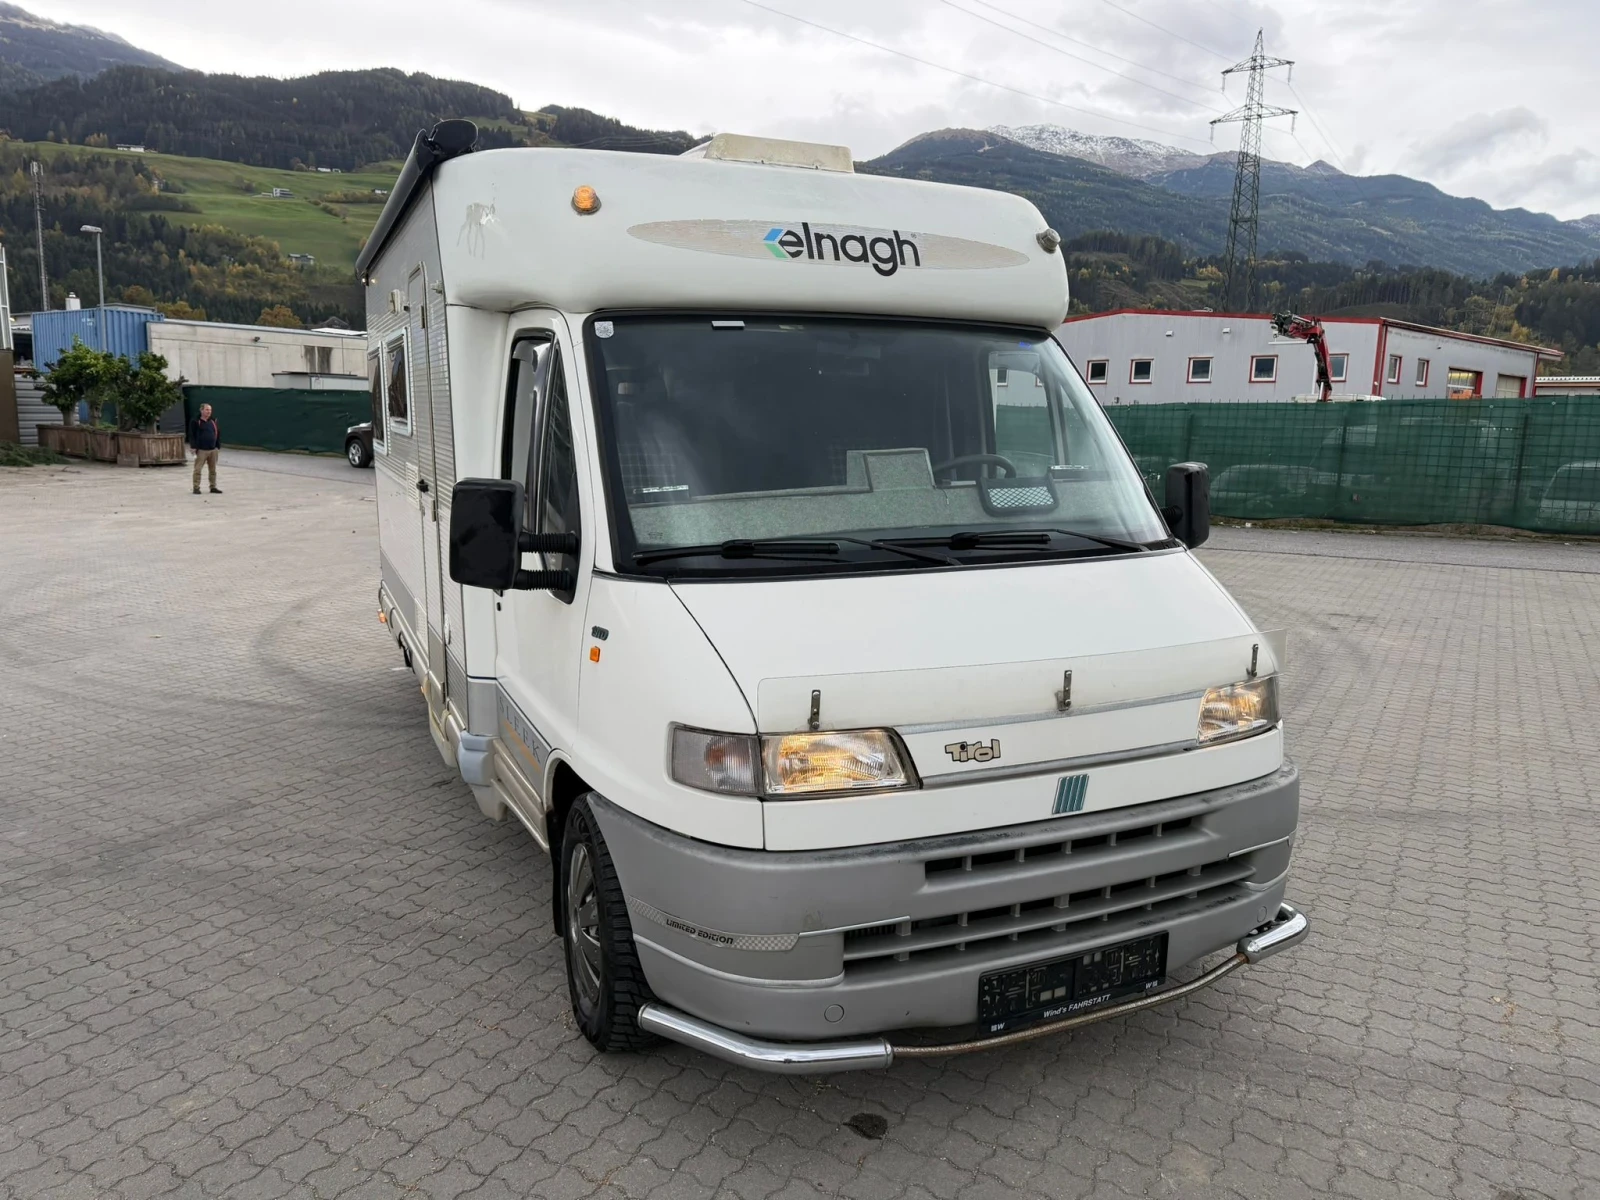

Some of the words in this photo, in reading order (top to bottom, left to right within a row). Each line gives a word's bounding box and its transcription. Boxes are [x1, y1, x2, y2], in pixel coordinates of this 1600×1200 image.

[778, 222, 920, 276] elnagh
[944, 738, 1001, 763] Tirol
[1043, 1008, 1068, 1018] Wind's
[1068, 994, 1111, 1011] FAHRSTATT
